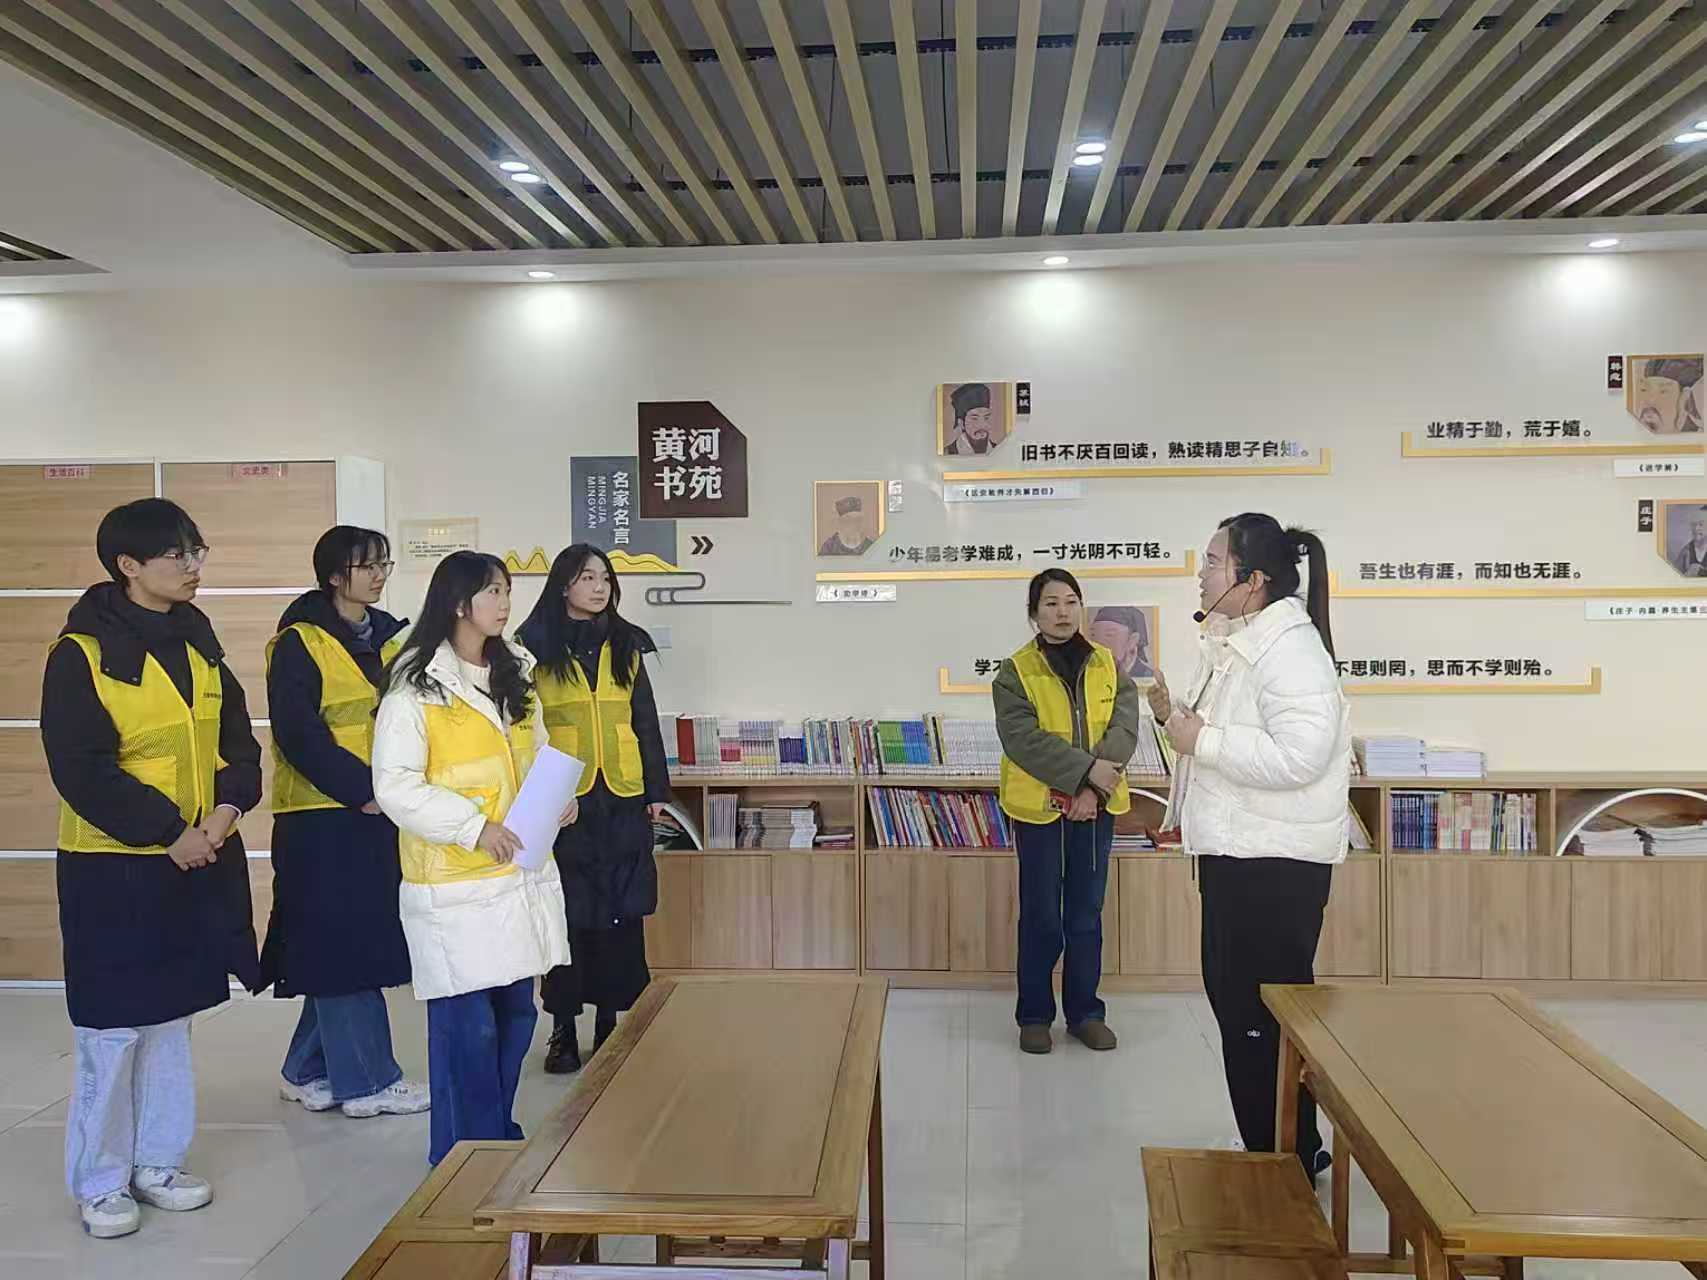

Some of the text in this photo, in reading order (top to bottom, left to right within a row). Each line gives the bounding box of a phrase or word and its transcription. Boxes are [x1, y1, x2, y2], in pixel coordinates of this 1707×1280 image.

[652, 427, 721, 462] 黄河
[1427, 420, 1592, 439] 业精于勤，荒于嬉。
[598, 475, 607, 524] MINGJIA
[653, 465, 723, 500] 书苑
[587, 475, 596, 529] MINGYAN
[612, 471, 631, 545] 名家名言
[1359, 561, 1583, 581] 吾生也有涯，而知也无涯。
[1335, 659, 1554, 678] 不思则罔，思而不学则殆。
